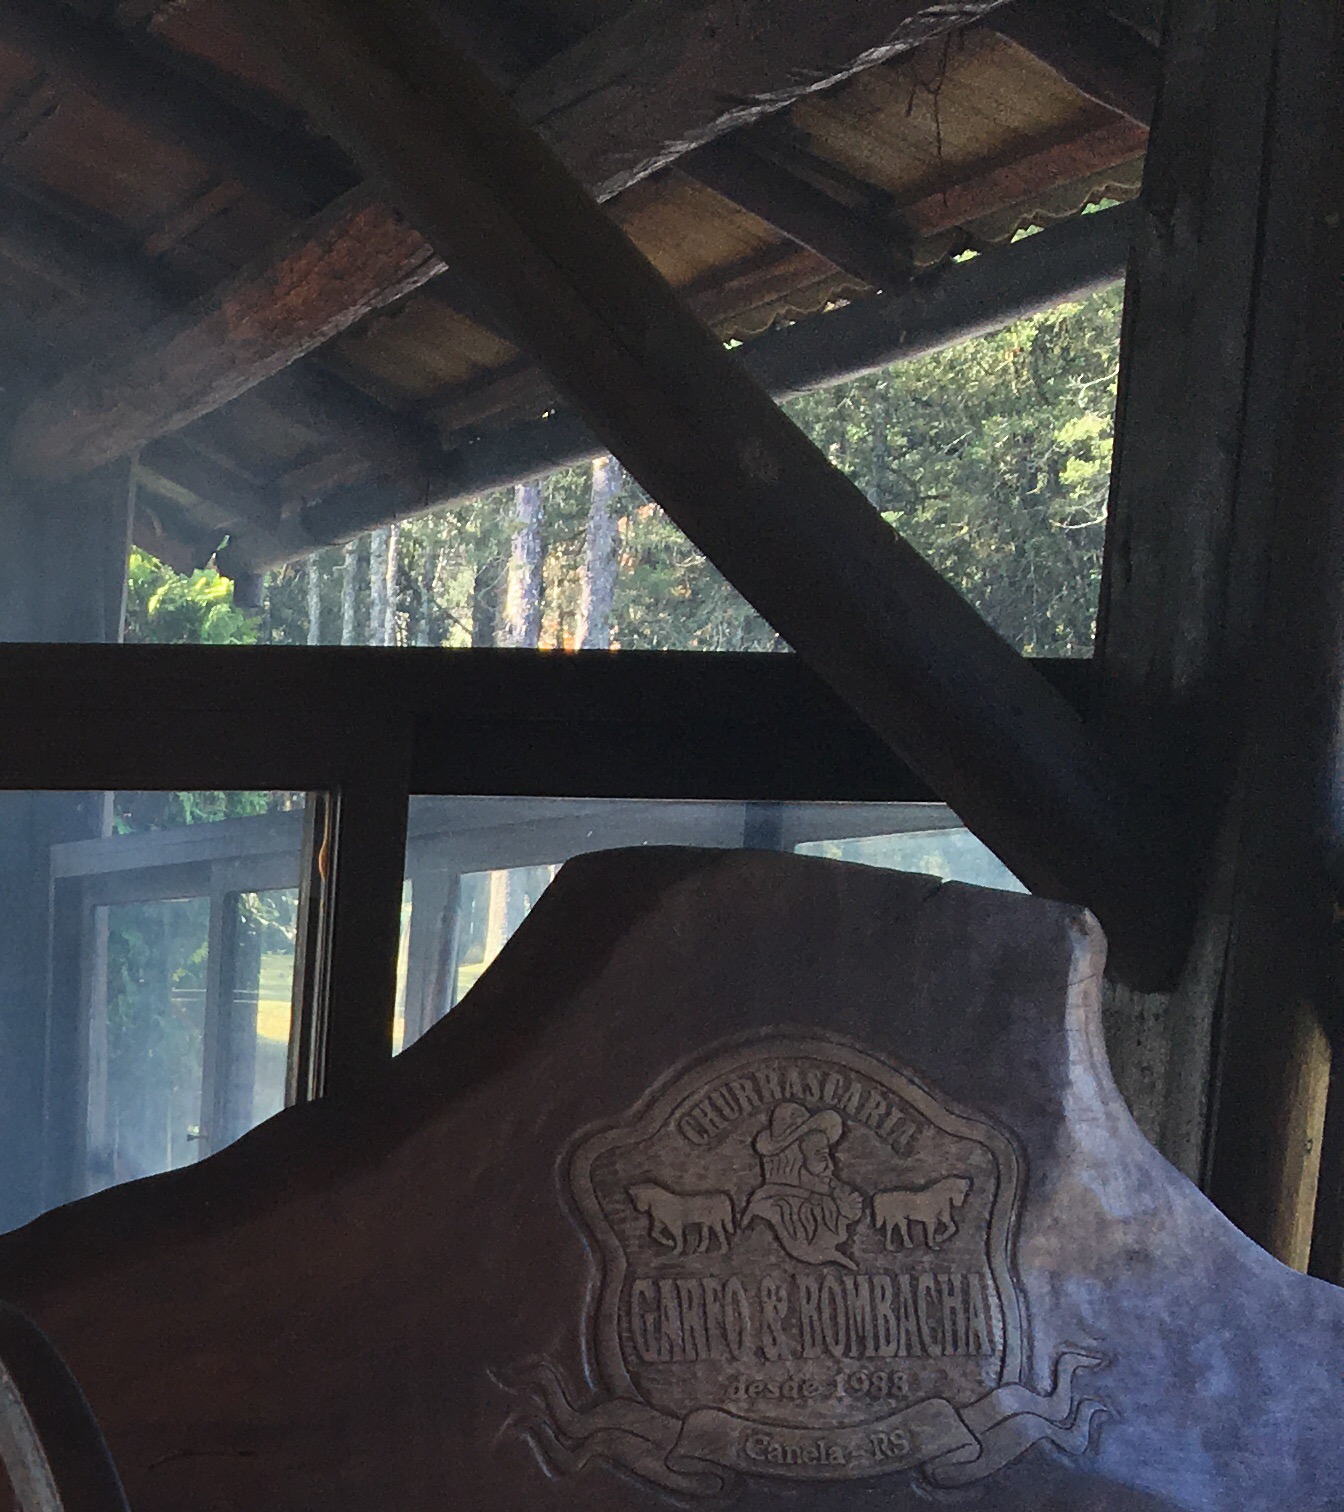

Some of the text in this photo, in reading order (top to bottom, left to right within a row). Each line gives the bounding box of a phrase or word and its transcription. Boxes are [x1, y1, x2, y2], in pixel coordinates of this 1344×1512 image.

[678, 1068, 916, 1153] CHURRASCARIA
[631, 1272, 995, 1362] GARFO & BOMBACHA
[727, 1371, 910, 1398] desde 1988
[745, 1434, 846, 1465] Canela
